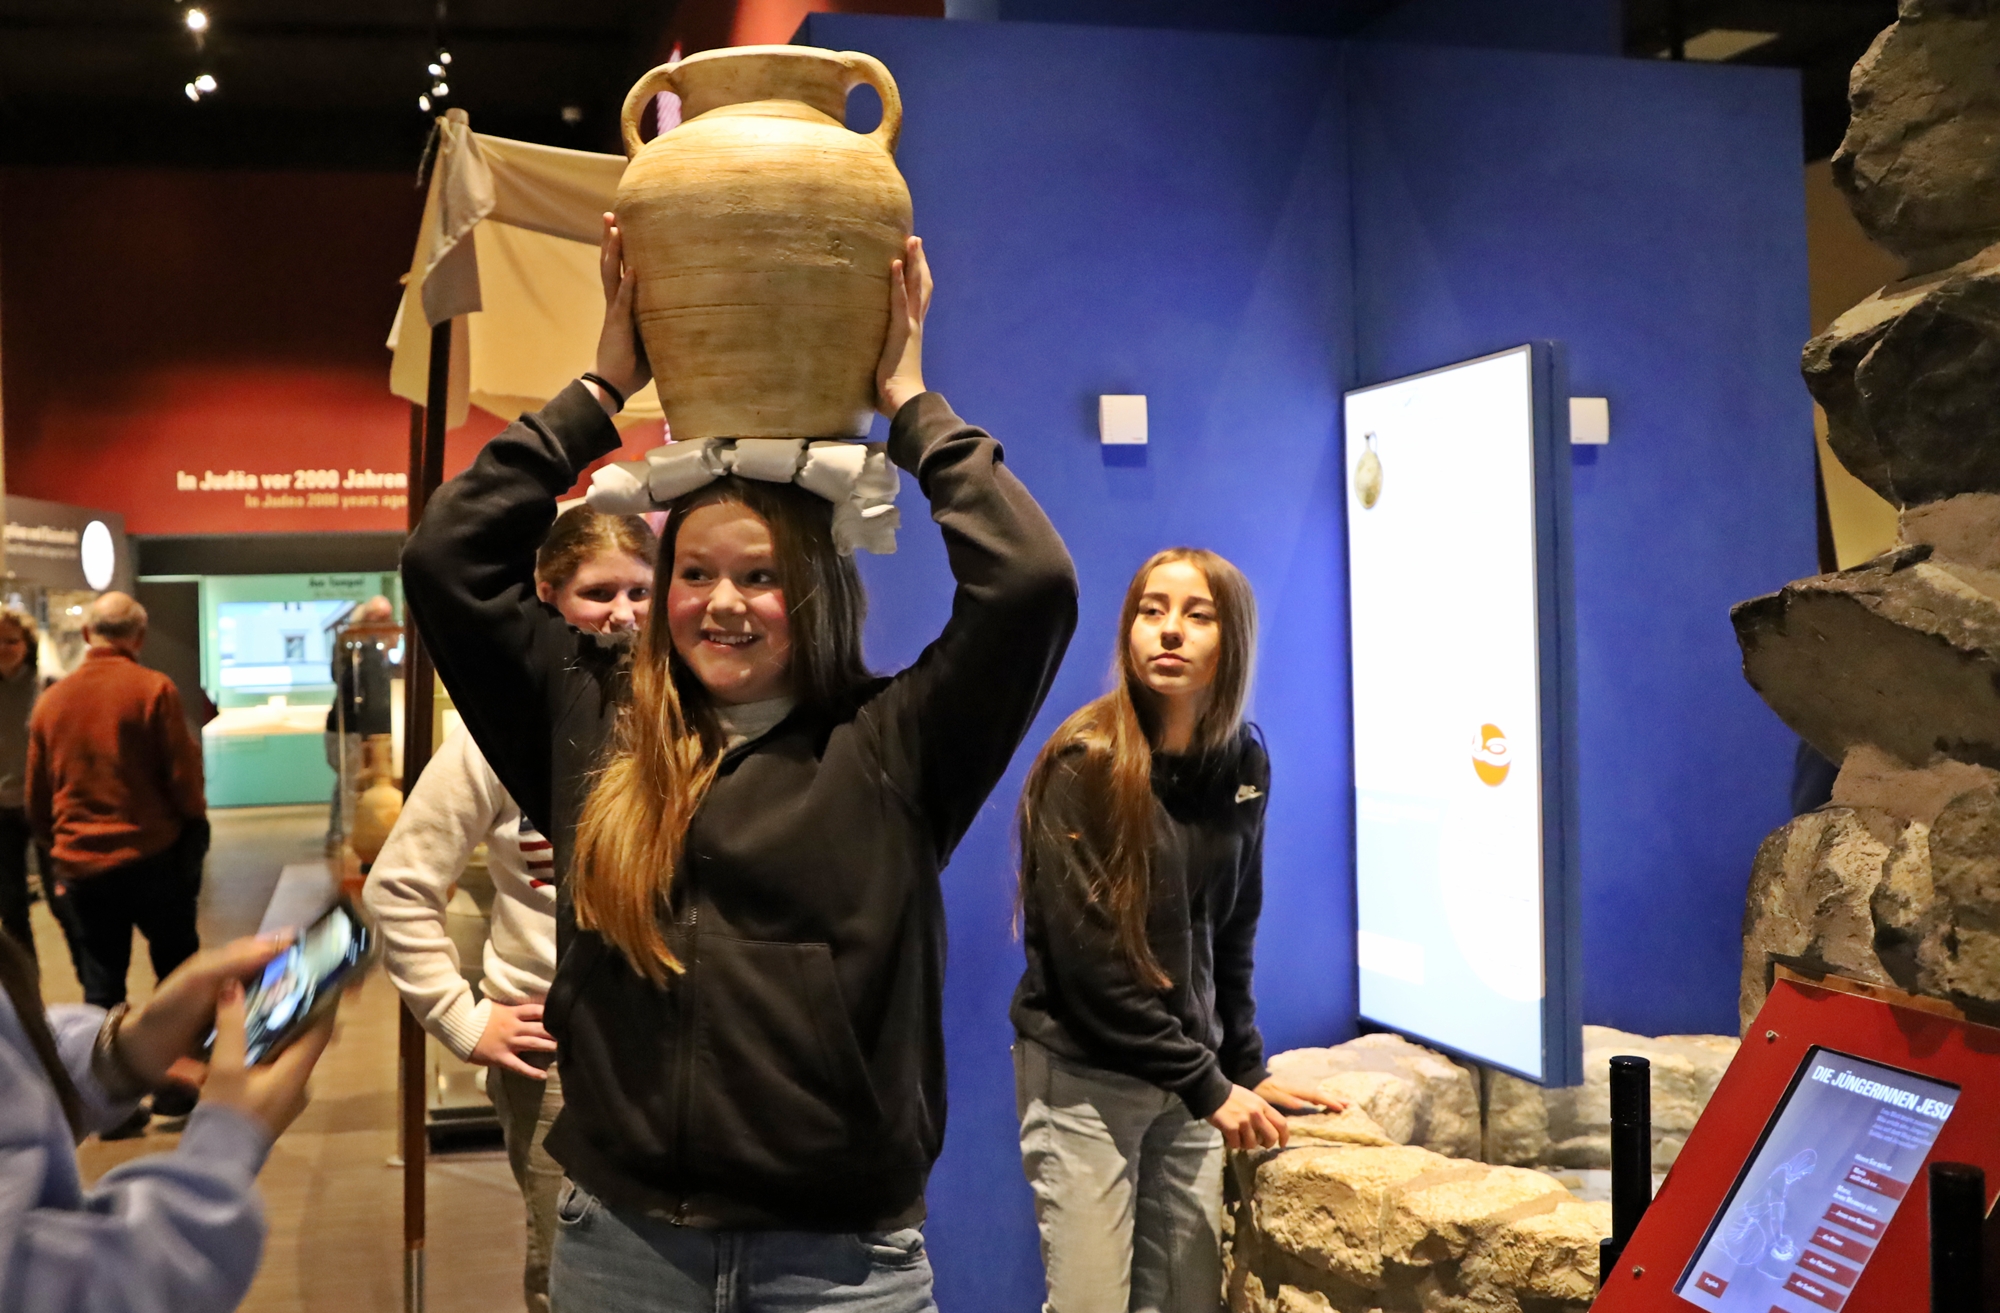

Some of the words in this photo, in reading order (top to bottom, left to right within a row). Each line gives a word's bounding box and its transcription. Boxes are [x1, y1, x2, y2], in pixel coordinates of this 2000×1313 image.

[177, 470, 197, 491] In
[199, 469, 259, 491] Judäa
[261, 473, 293, 490] vor
[293, 469, 340, 490] 2000
[342, 468, 408, 489] Jahren
[381, 494, 408, 510] ago
[1811, 1065, 1835, 1083] DIE
[1831, 1070, 1919, 1111] JÜNGERINNEN
[1915, 1097, 1954, 1121] JESU
